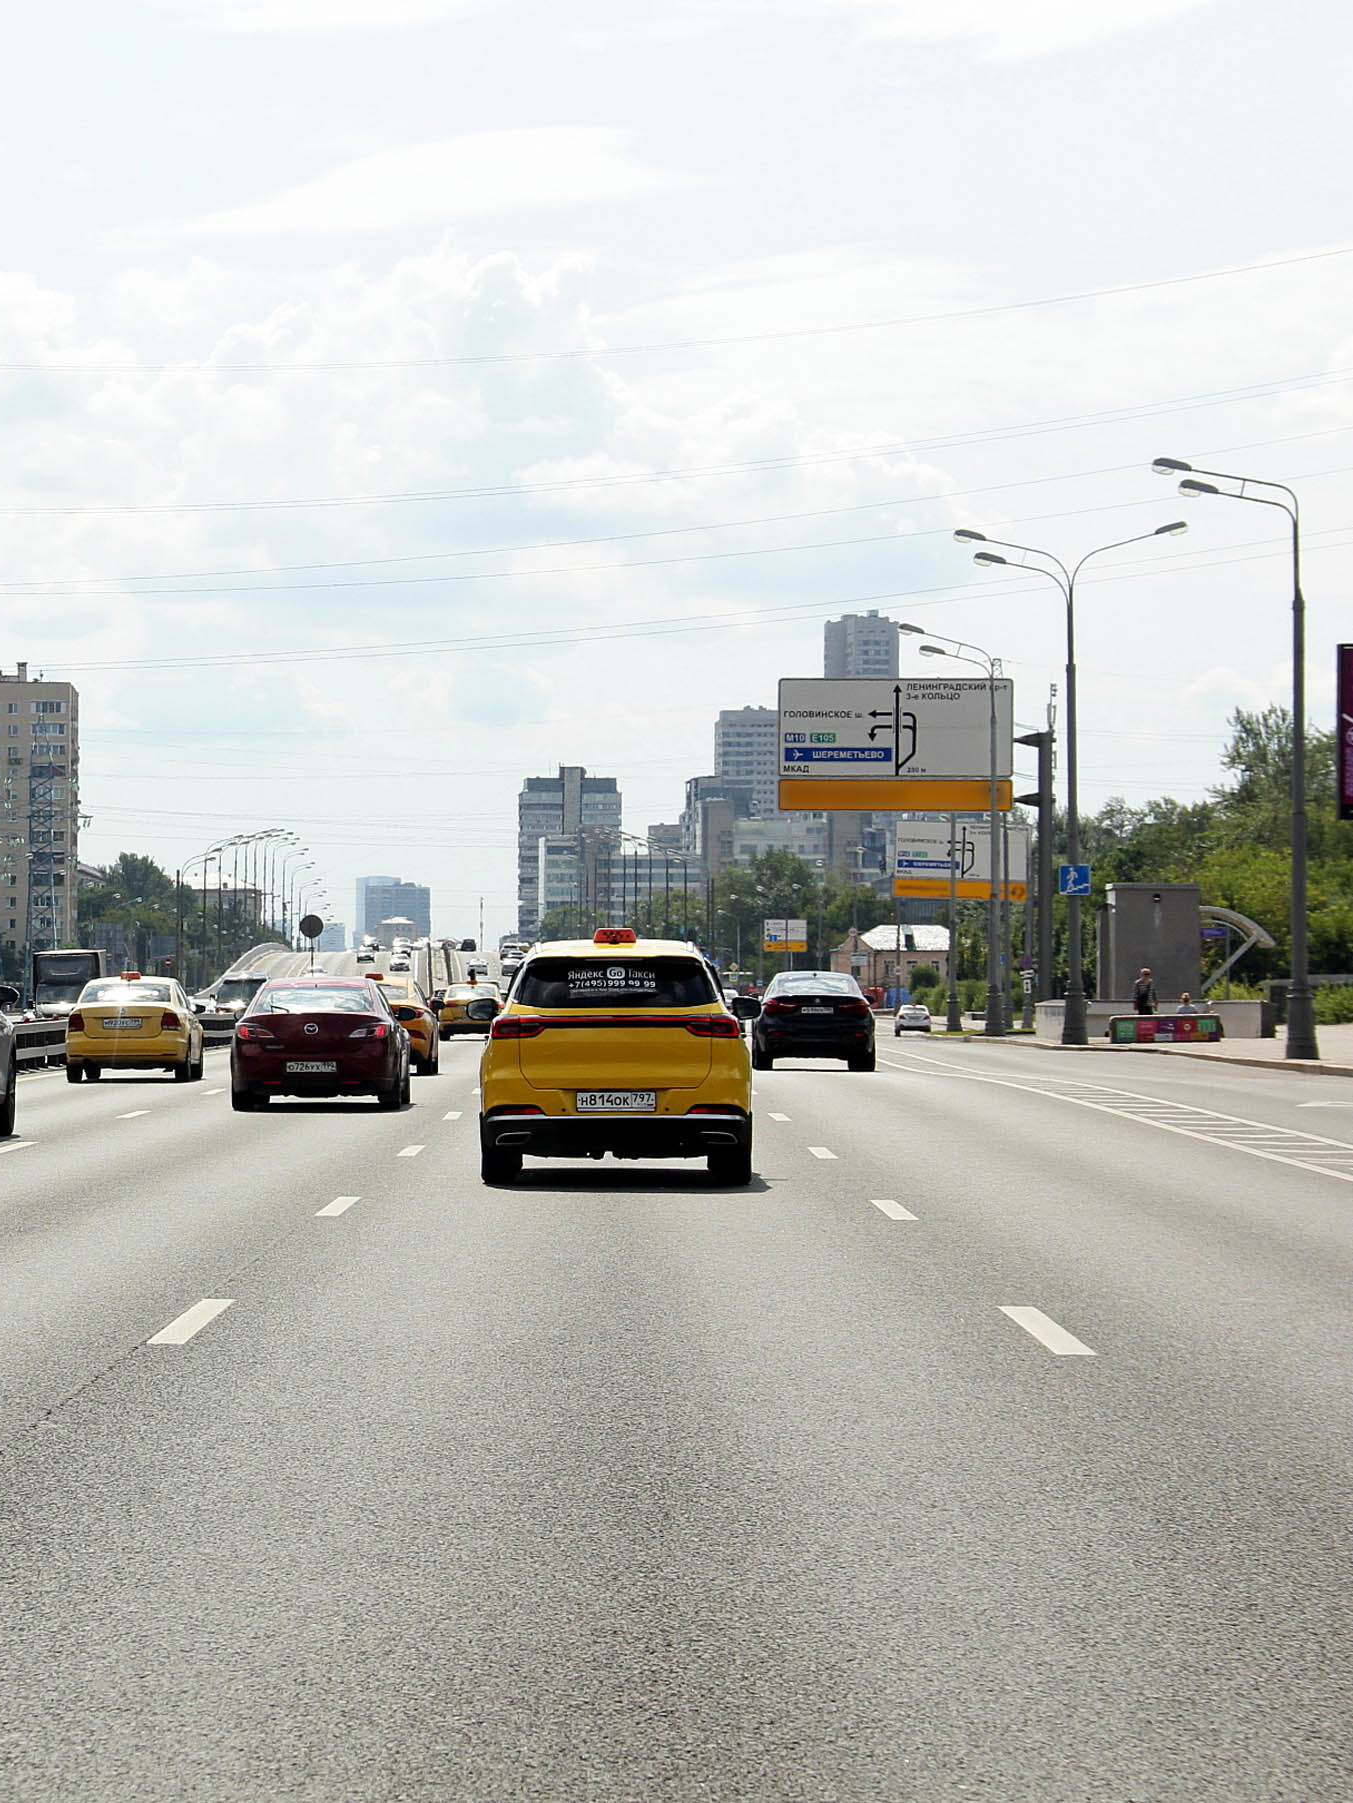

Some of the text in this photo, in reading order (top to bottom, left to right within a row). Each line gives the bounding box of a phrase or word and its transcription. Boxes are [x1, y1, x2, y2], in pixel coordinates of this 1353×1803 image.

[906, 682, 986, 691] ЛЕНИНГРАДСКИЙ
[921, 693, 961, 701] КОЛЬЦО
[783, 710, 853, 719] ГОЛОВИНСКОЕ
[812, 750, 885, 759] ШЕРЕМЕТЬЕВО
[783, 765, 810, 773] МКАД
[568, 968, 656, 979] Яндекс Go Такси
[632, 1093, 651, 1102] 797
